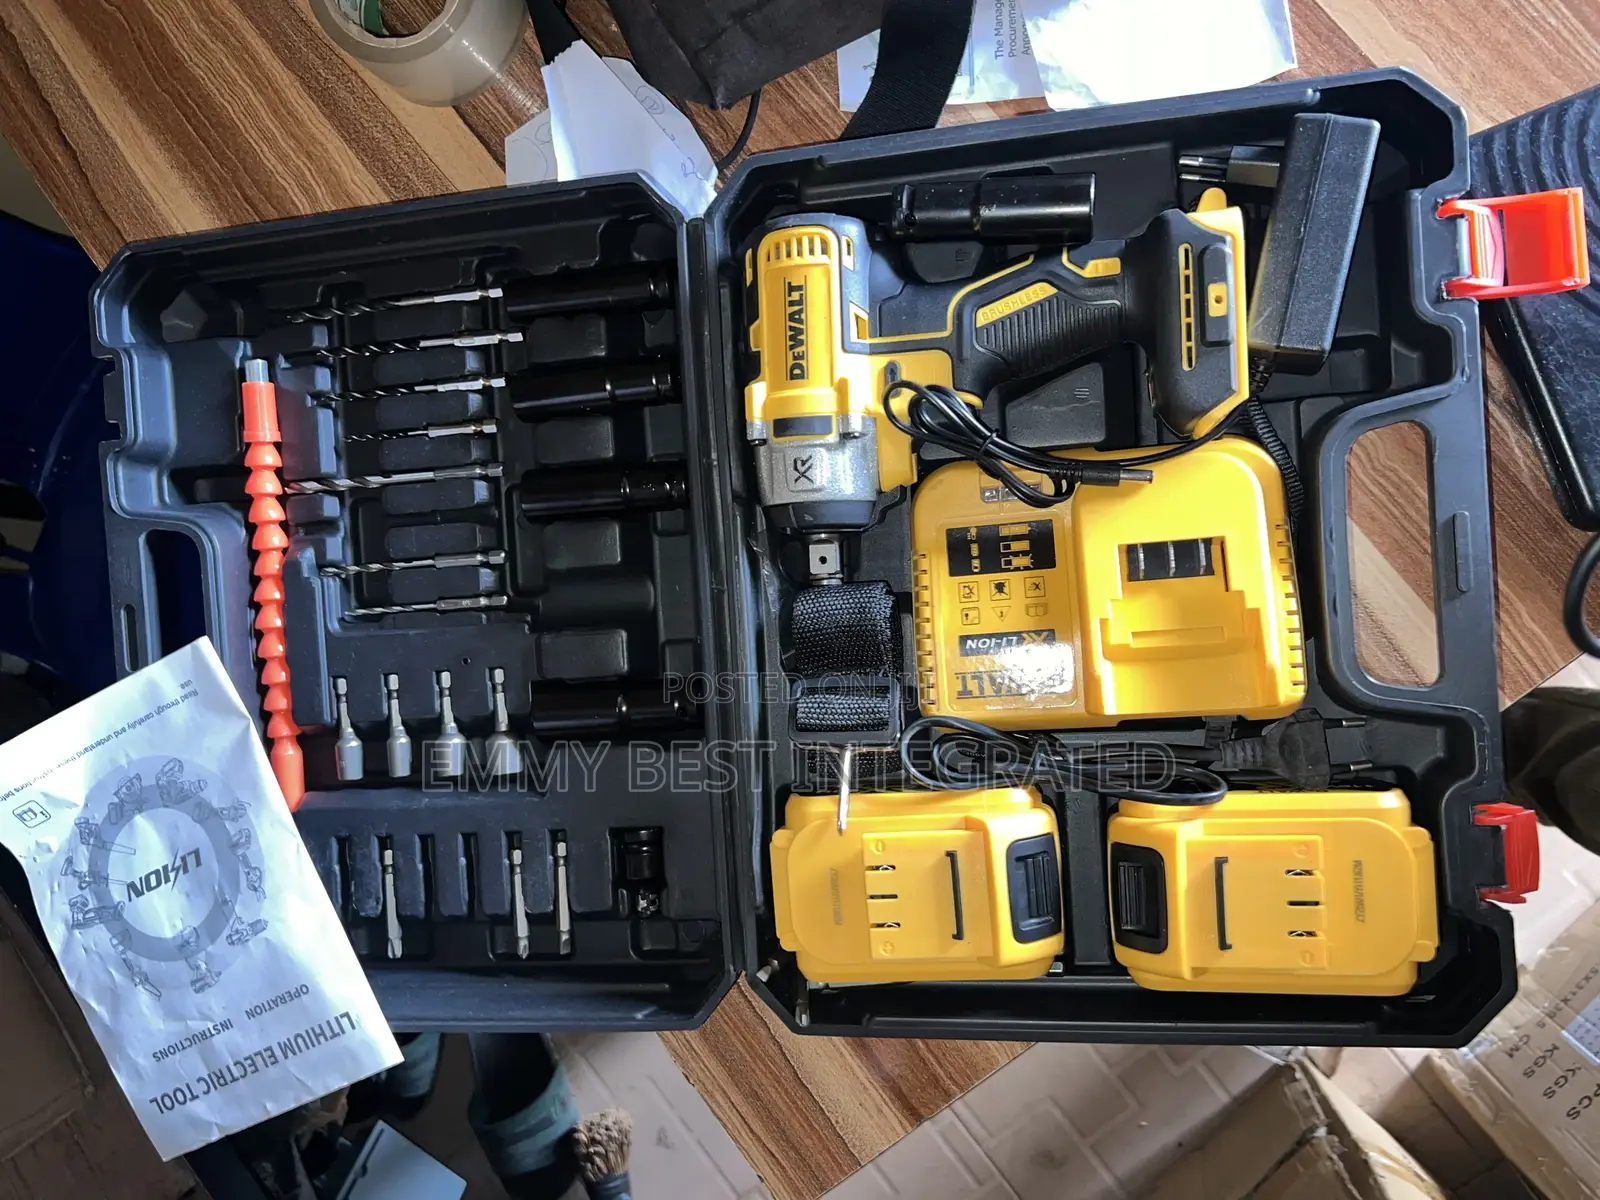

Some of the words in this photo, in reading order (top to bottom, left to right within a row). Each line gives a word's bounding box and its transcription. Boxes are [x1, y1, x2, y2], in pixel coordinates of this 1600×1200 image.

[994, 0, 1005, 37] Manag
[994, 39, 1004, 60] The
[981, 286, 1047, 321] BRUSHLESS
[787, 281, 805, 381] DEWALT
[793, 455, 815, 484] XR
[966, 636, 1019, 650] LI-ION
[153, 698, 180, 716] through
[179, 688, 199, 704] Read
[113, 727, 127, 740] and
[127, 712, 154, 731] carefully
[76, 734, 114, 759] understand
[245, 983, 310, 1021] OPERATION
[152, 1018, 234, 1062] INSTRUCTIONS
[277, 1011, 356, 1061] LITHIUM
[197, 1046, 280, 1096] ELECTRIC
[1522, 1043, 1560, 1079] KGS
[1543, 1064, 1582, 1099] KGS
[149, 1086, 199, 1115] TOOL
